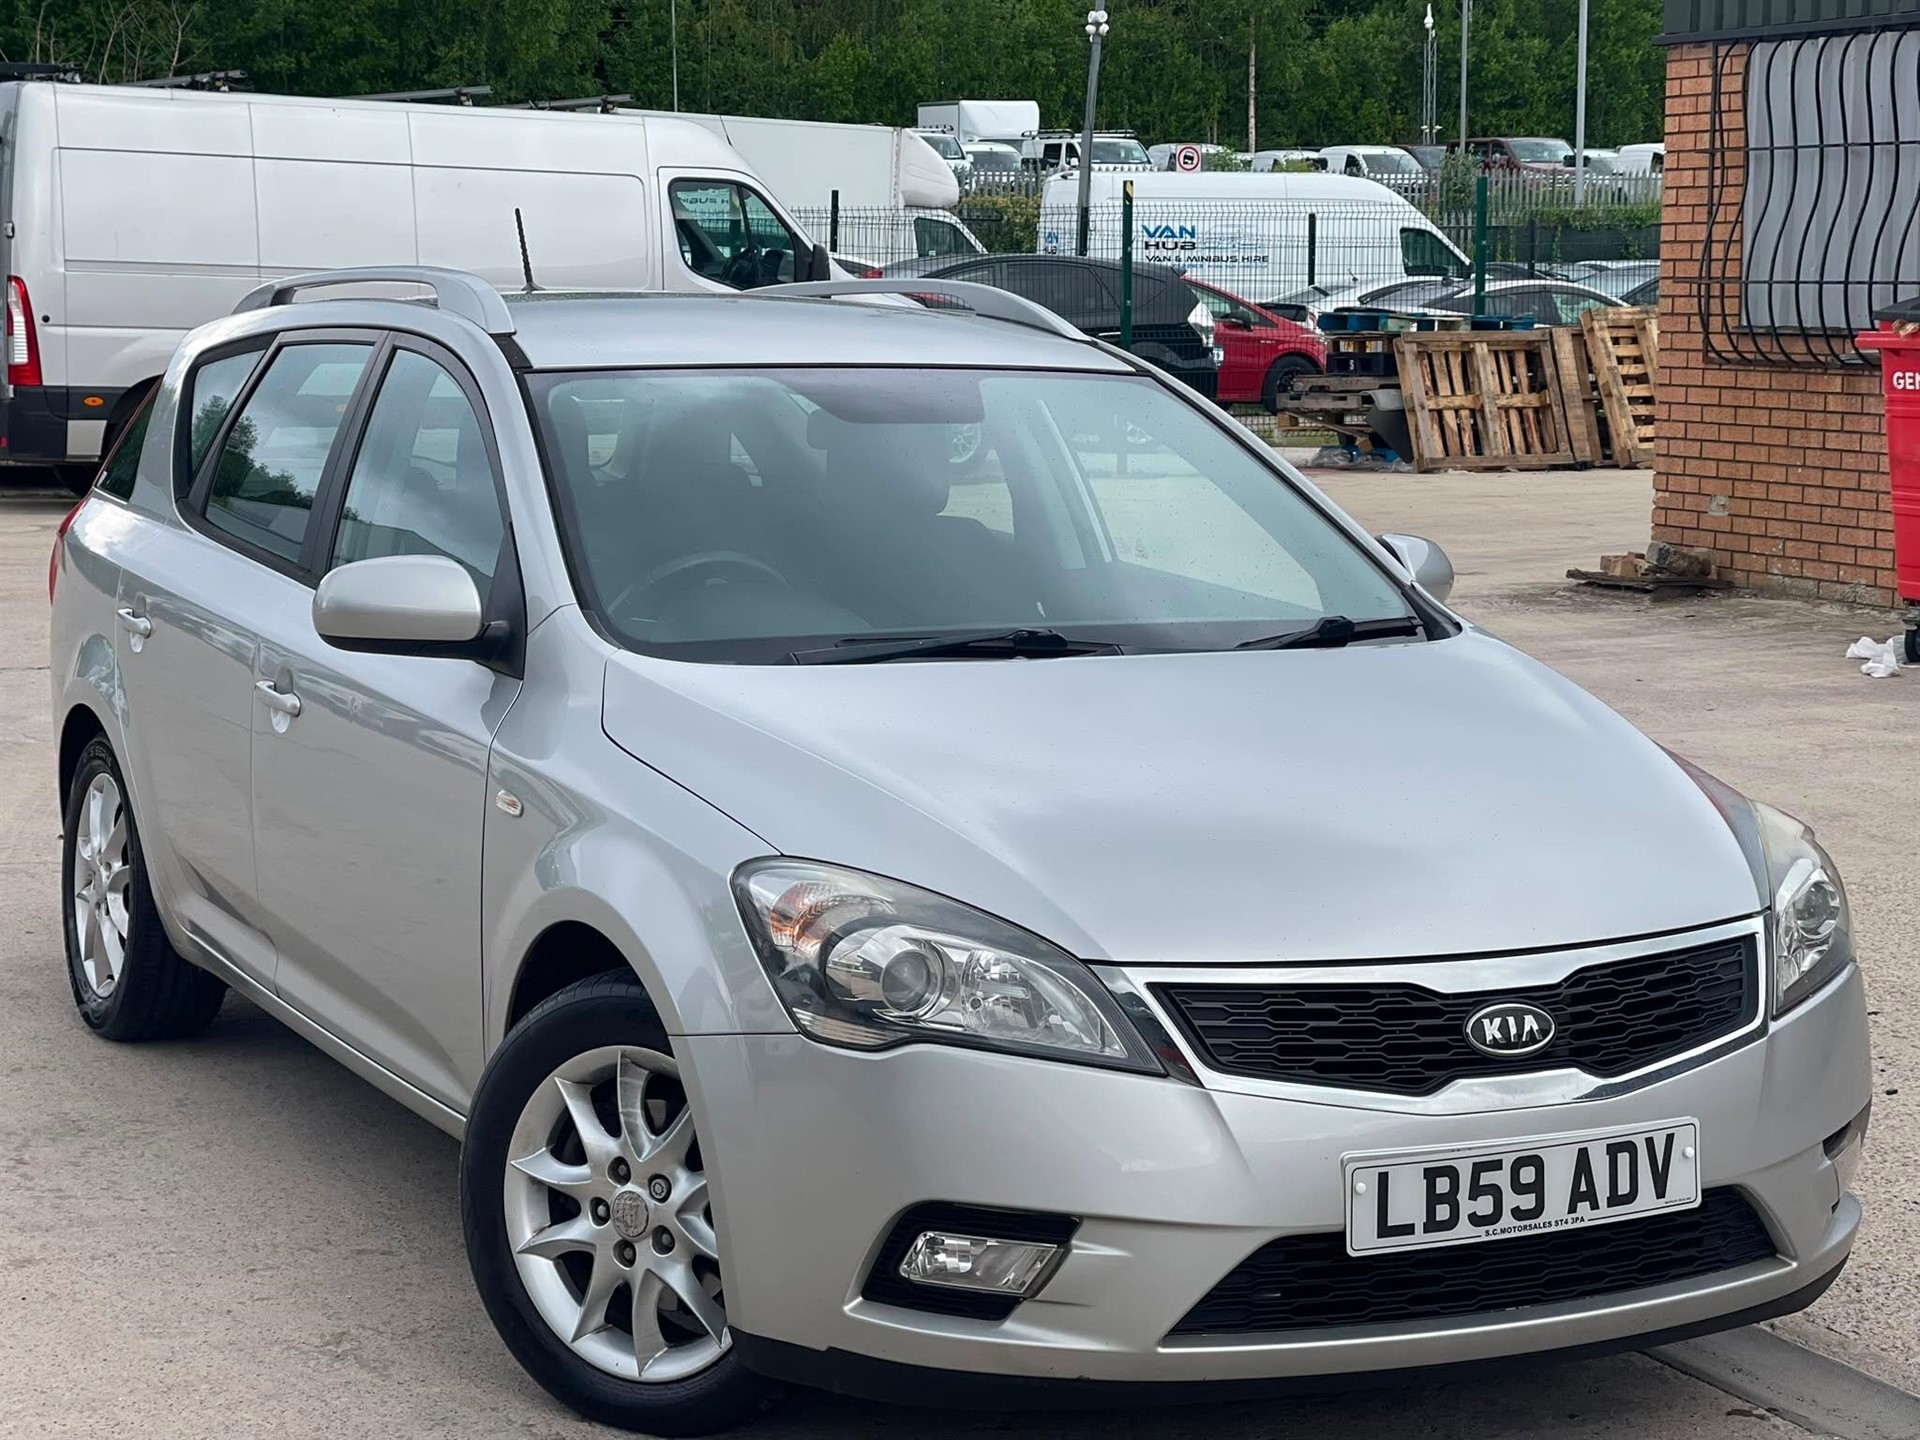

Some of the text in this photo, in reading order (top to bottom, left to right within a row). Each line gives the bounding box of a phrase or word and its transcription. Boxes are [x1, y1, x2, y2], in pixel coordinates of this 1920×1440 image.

[1142, 225, 1196, 239] VAN
[1145, 241, 1197, 251] HUB
[1146, 255, 1269, 263] VAN & MINIBUS HIRE
[1481, 1014, 1544, 1045] KIA
[1376, 1132, 1676, 1239] LB59 ADV
[1485, 1216, 1586, 1237] S.C.MOTORSALES ST4 3PA
